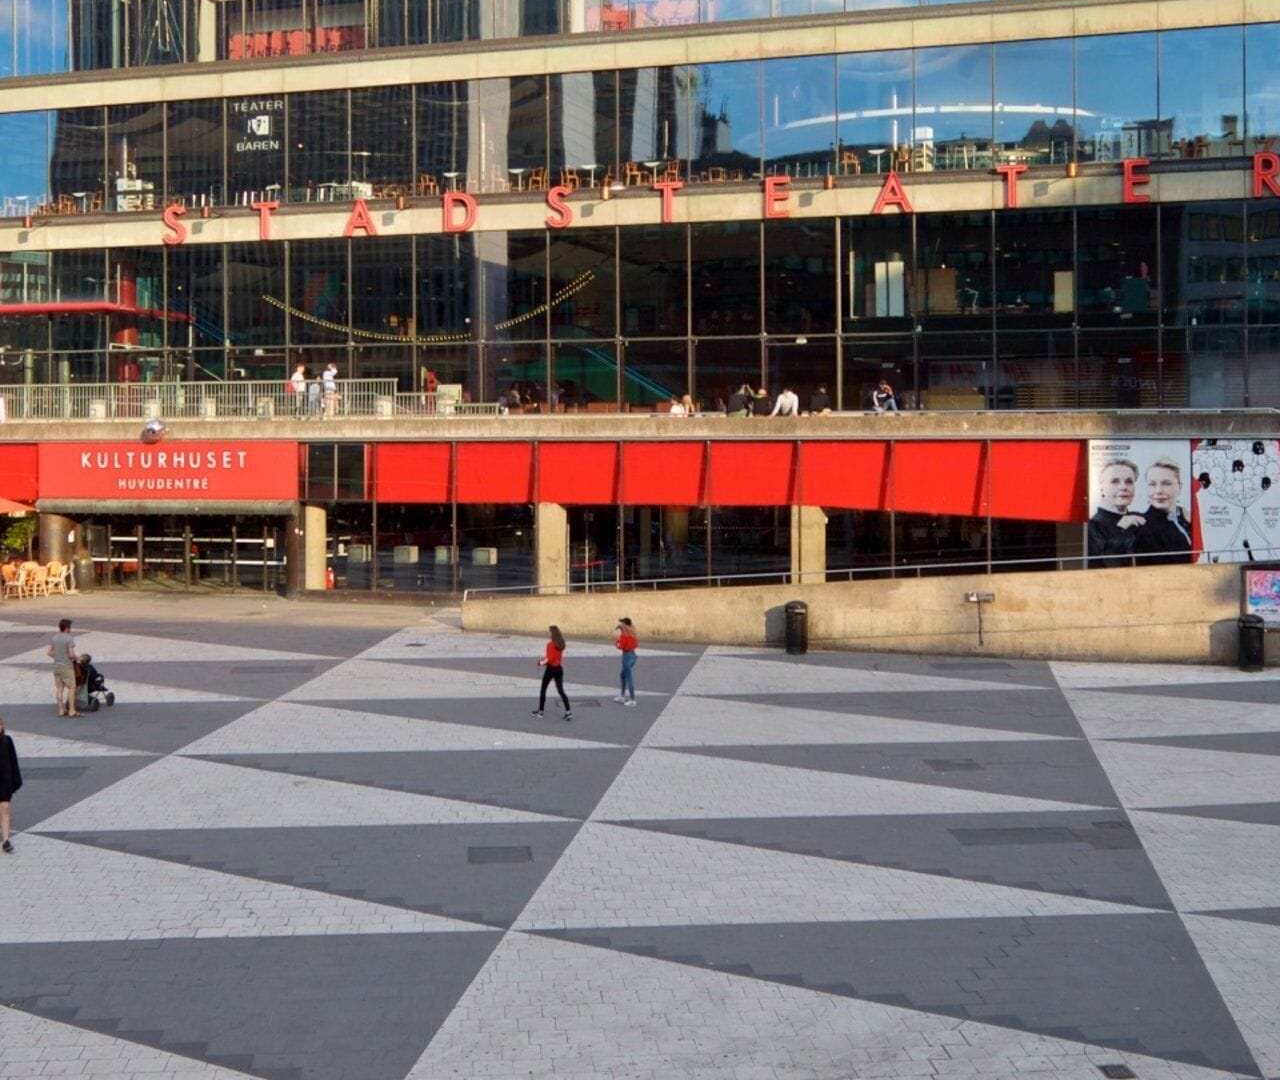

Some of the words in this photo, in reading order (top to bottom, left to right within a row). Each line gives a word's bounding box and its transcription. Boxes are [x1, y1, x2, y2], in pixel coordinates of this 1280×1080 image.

[233, 101, 283, 113] TEATER
[236, 140, 279, 152] BAREN
[80, 451, 247, 468] KULTURHUSET
[118, 476, 208, 490] HUVUDENTRÉ
